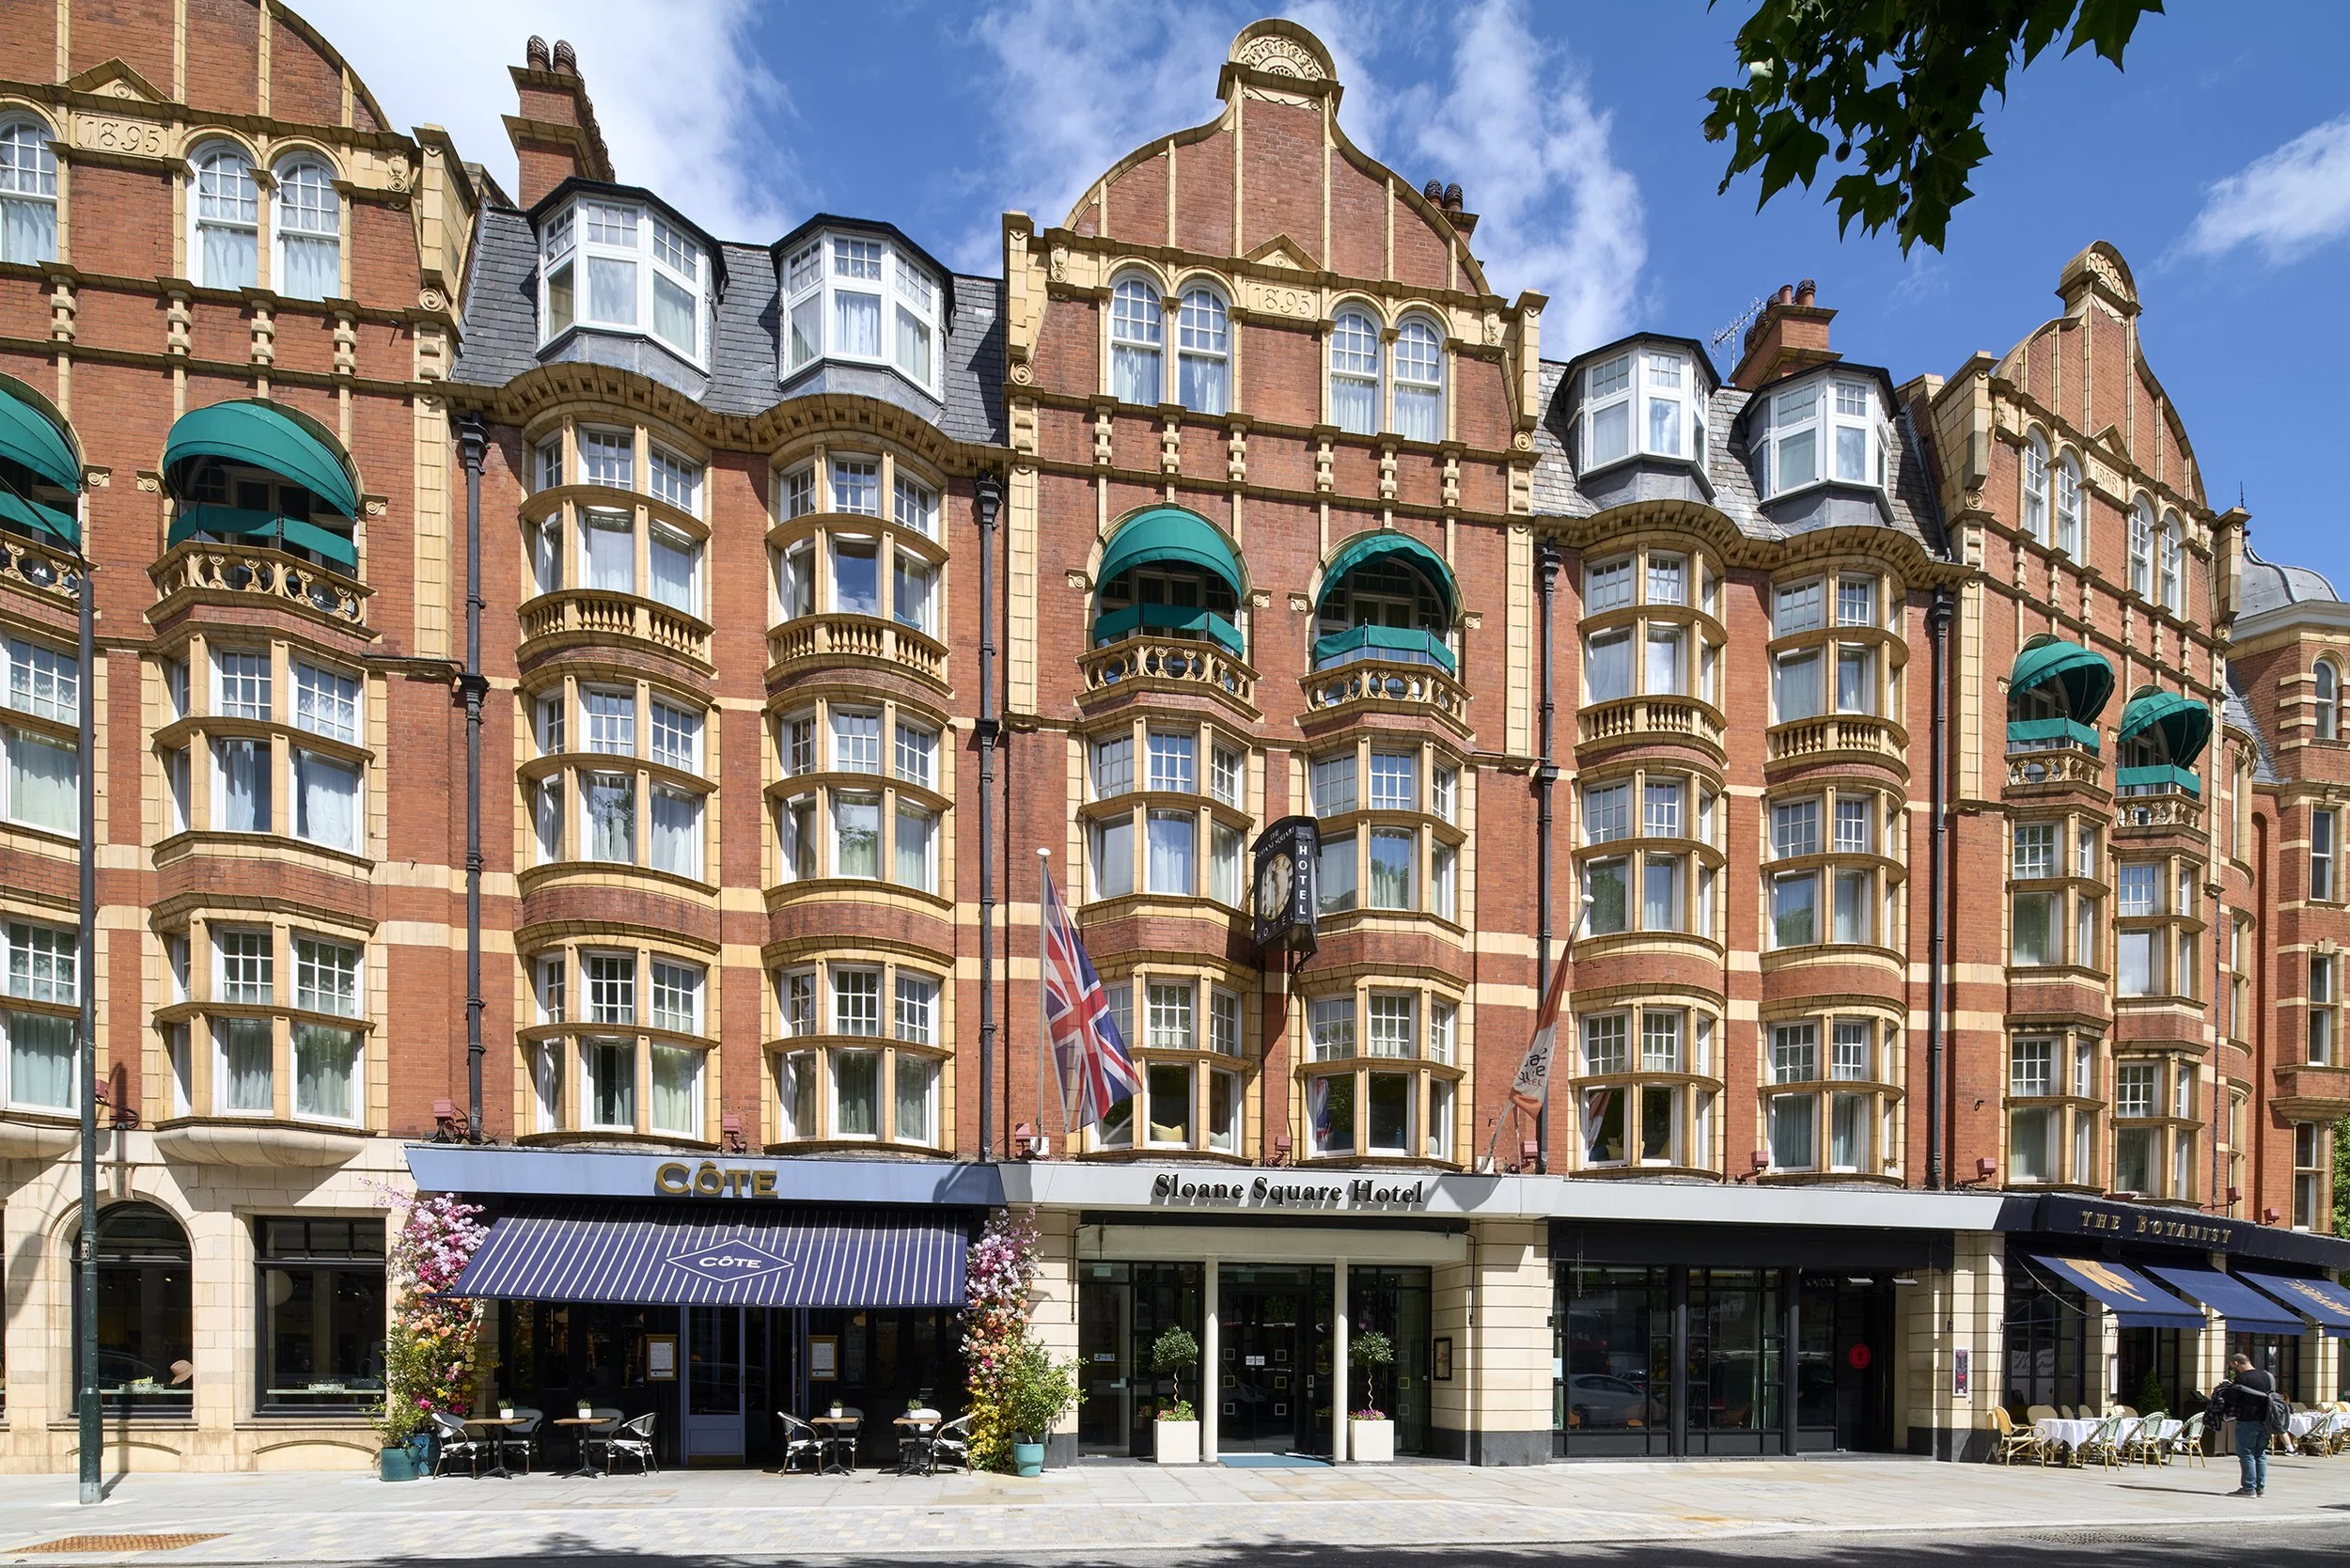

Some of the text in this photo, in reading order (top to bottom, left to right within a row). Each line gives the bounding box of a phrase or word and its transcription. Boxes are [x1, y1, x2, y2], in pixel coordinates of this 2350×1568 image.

[86, 119, 161, 153] 1895
[1253, 287, 1310, 315] 1895
[1298, 845, 1308, 915] HOTEL
[1256, 911, 1294, 942] HOTEL
[655, 1160, 778, 1196] CÔTE
[1154, 1173, 1424, 1205] Sloane Square Hotel
[2081, 1211, 2232, 1244] THE BOTANIST
[698, 1255, 762, 1269] CÔTE
